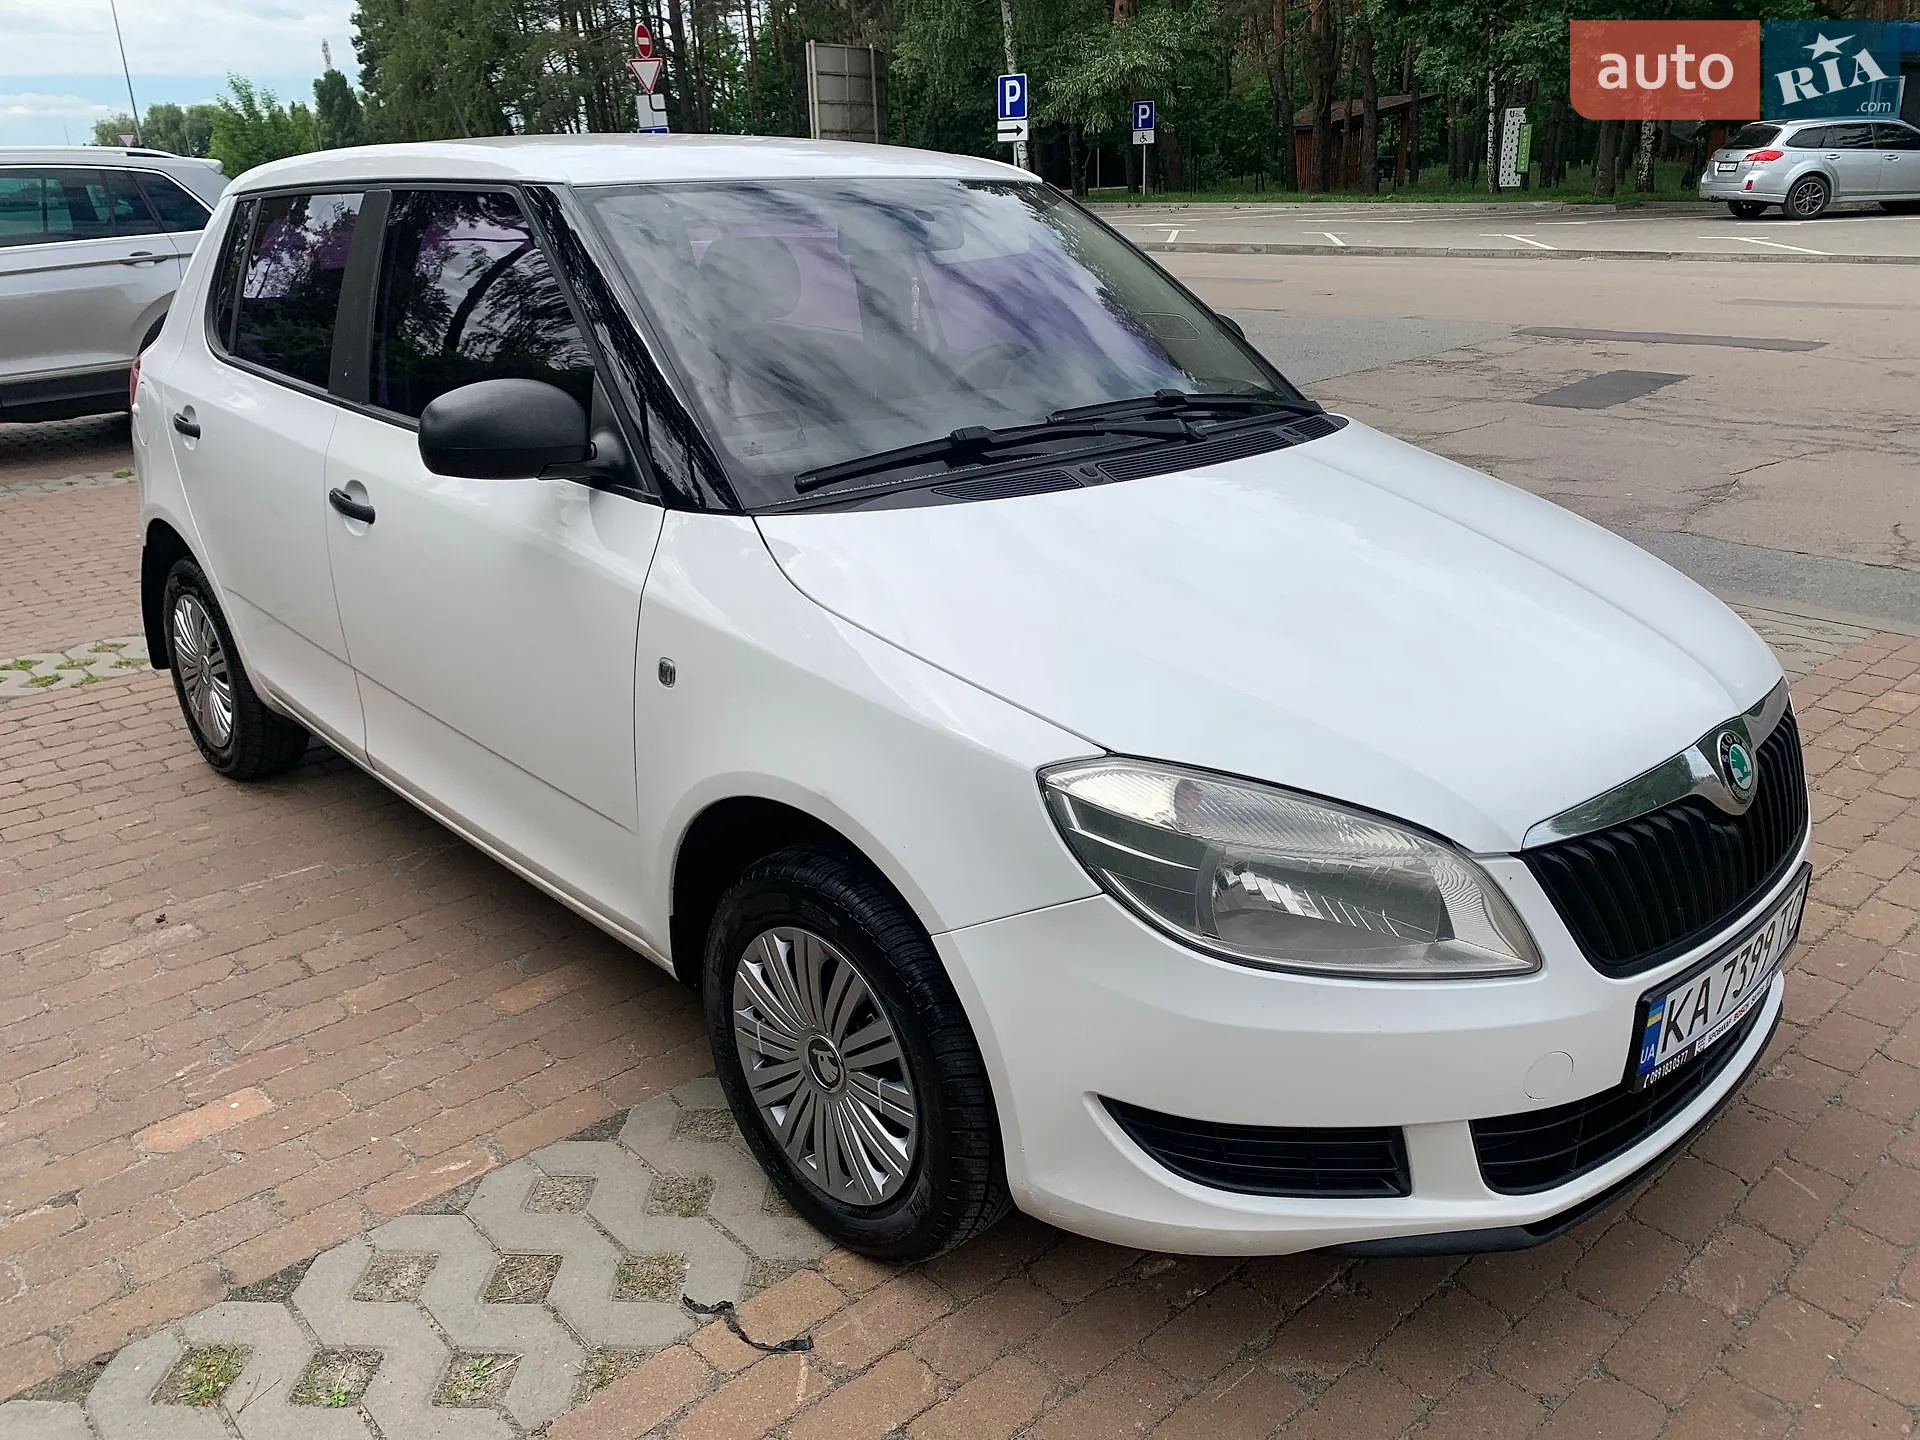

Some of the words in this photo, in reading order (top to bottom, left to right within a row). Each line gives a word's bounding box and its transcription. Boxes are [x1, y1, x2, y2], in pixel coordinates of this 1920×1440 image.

[1005, 79, 1020, 116] P
[1138, 104, 1150, 128] P
[1661, 976, 1711, 1054] KA
[1716, 921, 1776, 1016] 7399
[1640, 1043, 1655, 1064] UA
